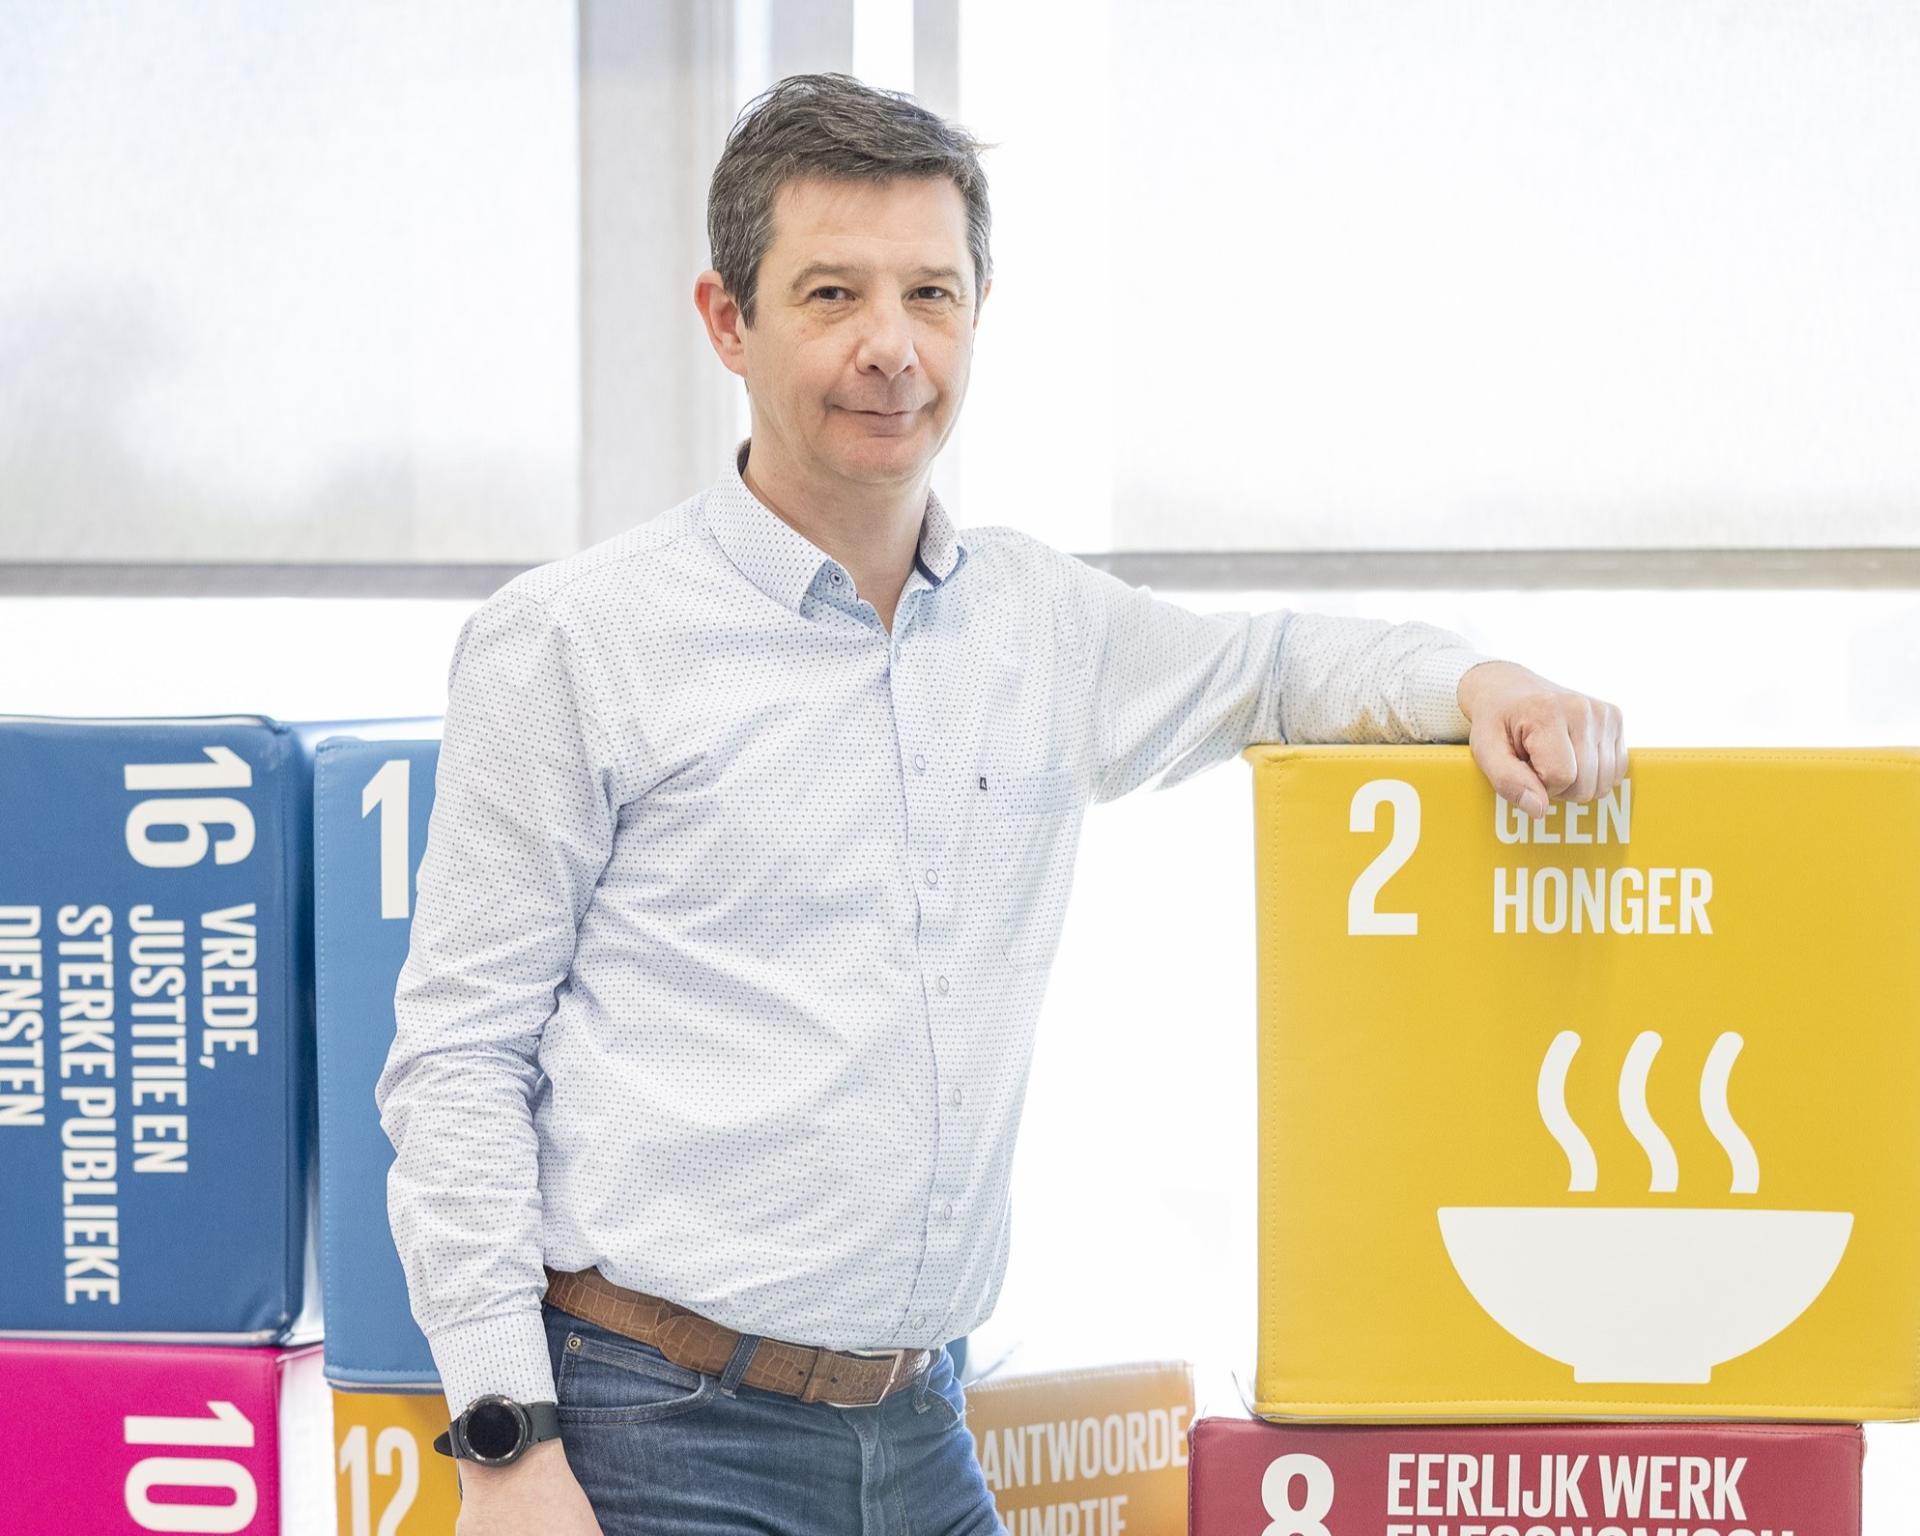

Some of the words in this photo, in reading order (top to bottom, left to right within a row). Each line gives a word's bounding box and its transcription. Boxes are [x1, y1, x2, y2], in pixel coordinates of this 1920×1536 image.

[124, 745, 256, 868] 16
[362, 760, 419, 919] 1
[1348, 779, 1421, 936] 2
[1493, 867, 1713, 934] HONGER
[0, 905, 45, 1126] DIENSTEN
[57, 904, 115, 1079] STERKE
[129, 904, 187, 1106] JUSTITIE
[200, 903, 258, 1069] VREDE,
[61, 1086, 120, 1305] PUBLIEKE
[133, 1115, 188, 1173] EN
[124, 1401, 257, 1534] 10
[339, 1425, 419, 1536] 12
[982, 1406, 1188, 1490] ANTWOORDE
[1261, 1453, 1335, 1536] 8
[1387, 1453, 1589, 1518] EERLIJK
[1599, 1455, 1748, 1521] WERK
